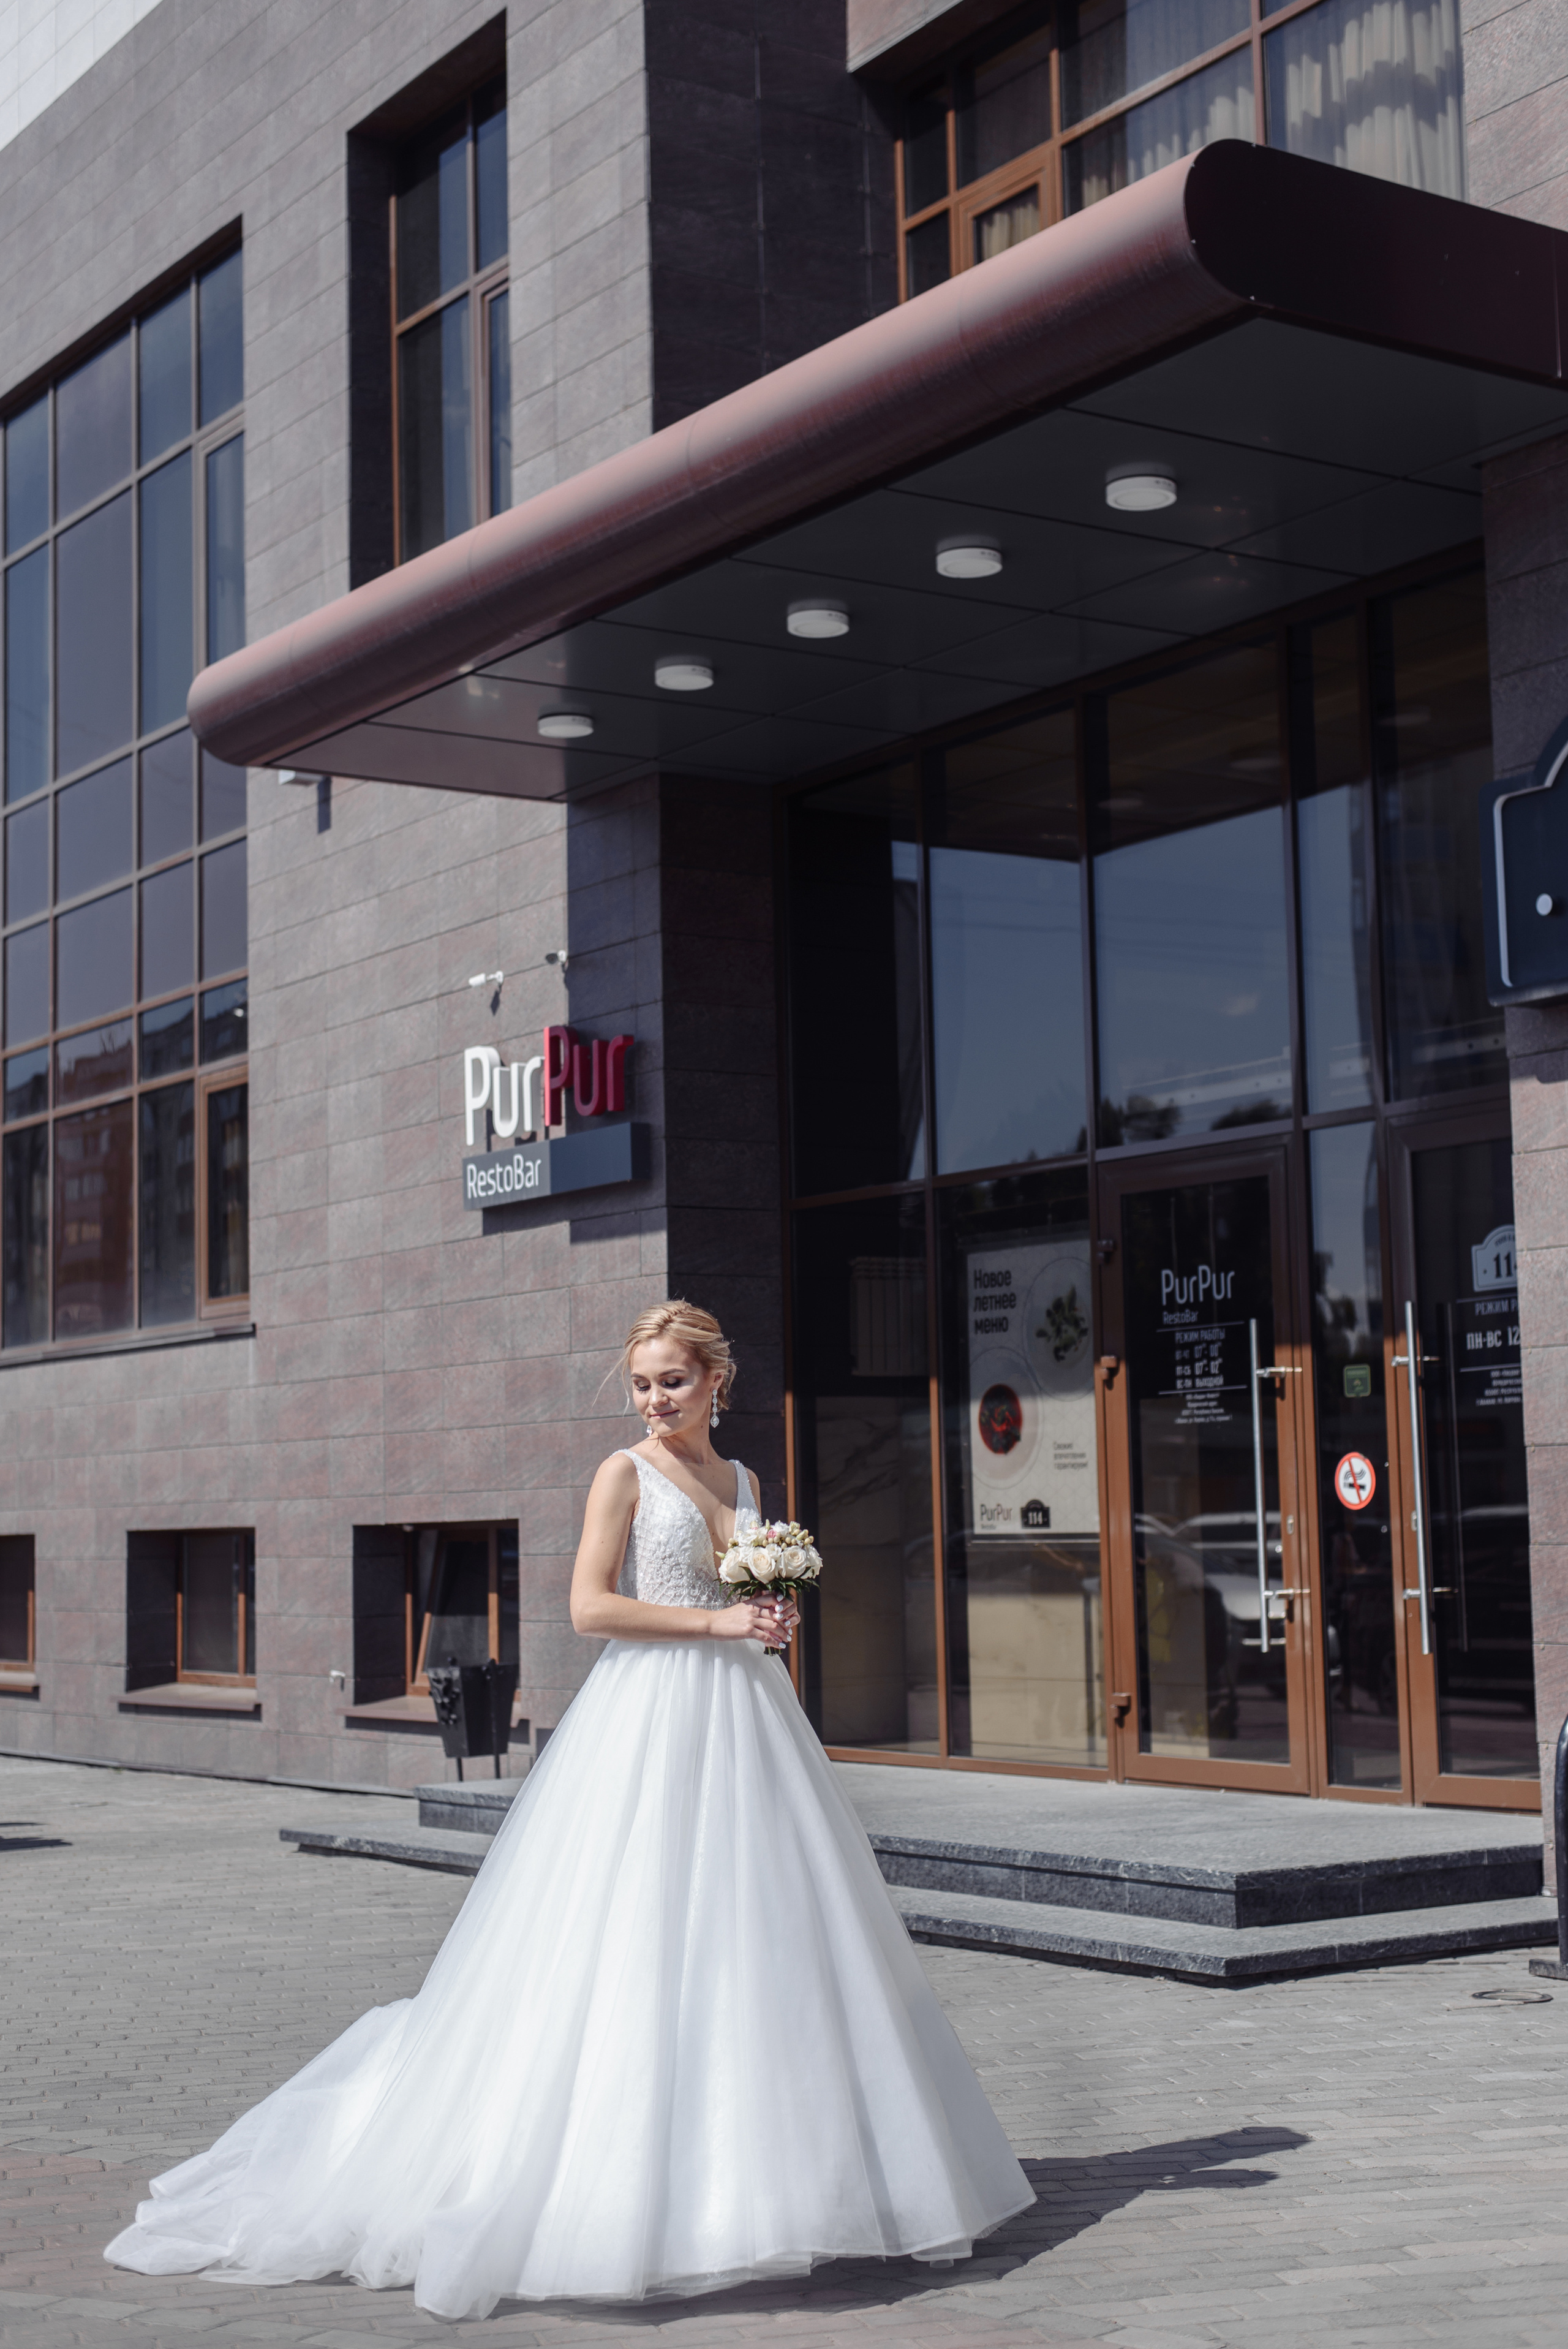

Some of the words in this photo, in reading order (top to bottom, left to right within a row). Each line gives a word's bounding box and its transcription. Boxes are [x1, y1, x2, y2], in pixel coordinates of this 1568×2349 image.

[464, 1026, 634, 1146] PurPur
[467, 1154, 542, 1200] RestoBar
[1494, 1252, 1518, 1279] 11
[974, 1269, 1012, 1289] Новое
[1161, 1265, 1235, 1306] PurPur
[973, 1292, 1017, 1312] летнее
[1474, 1299, 1509, 1316] РЕЖИМ
[974, 1316, 1009, 1334] меню
[1163, 1309, 1199, 1325] RestoBar
[1175, 1331, 1199, 1344] РЕЖИМ
[1200, 1328, 1226, 1341] РАБОТЫ
[1466, 1330, 1502, 1350] ПН-ВС
[980, 1504, 1012, 1521] PurPur
[1028, 1511, 1043, 1524] 114
